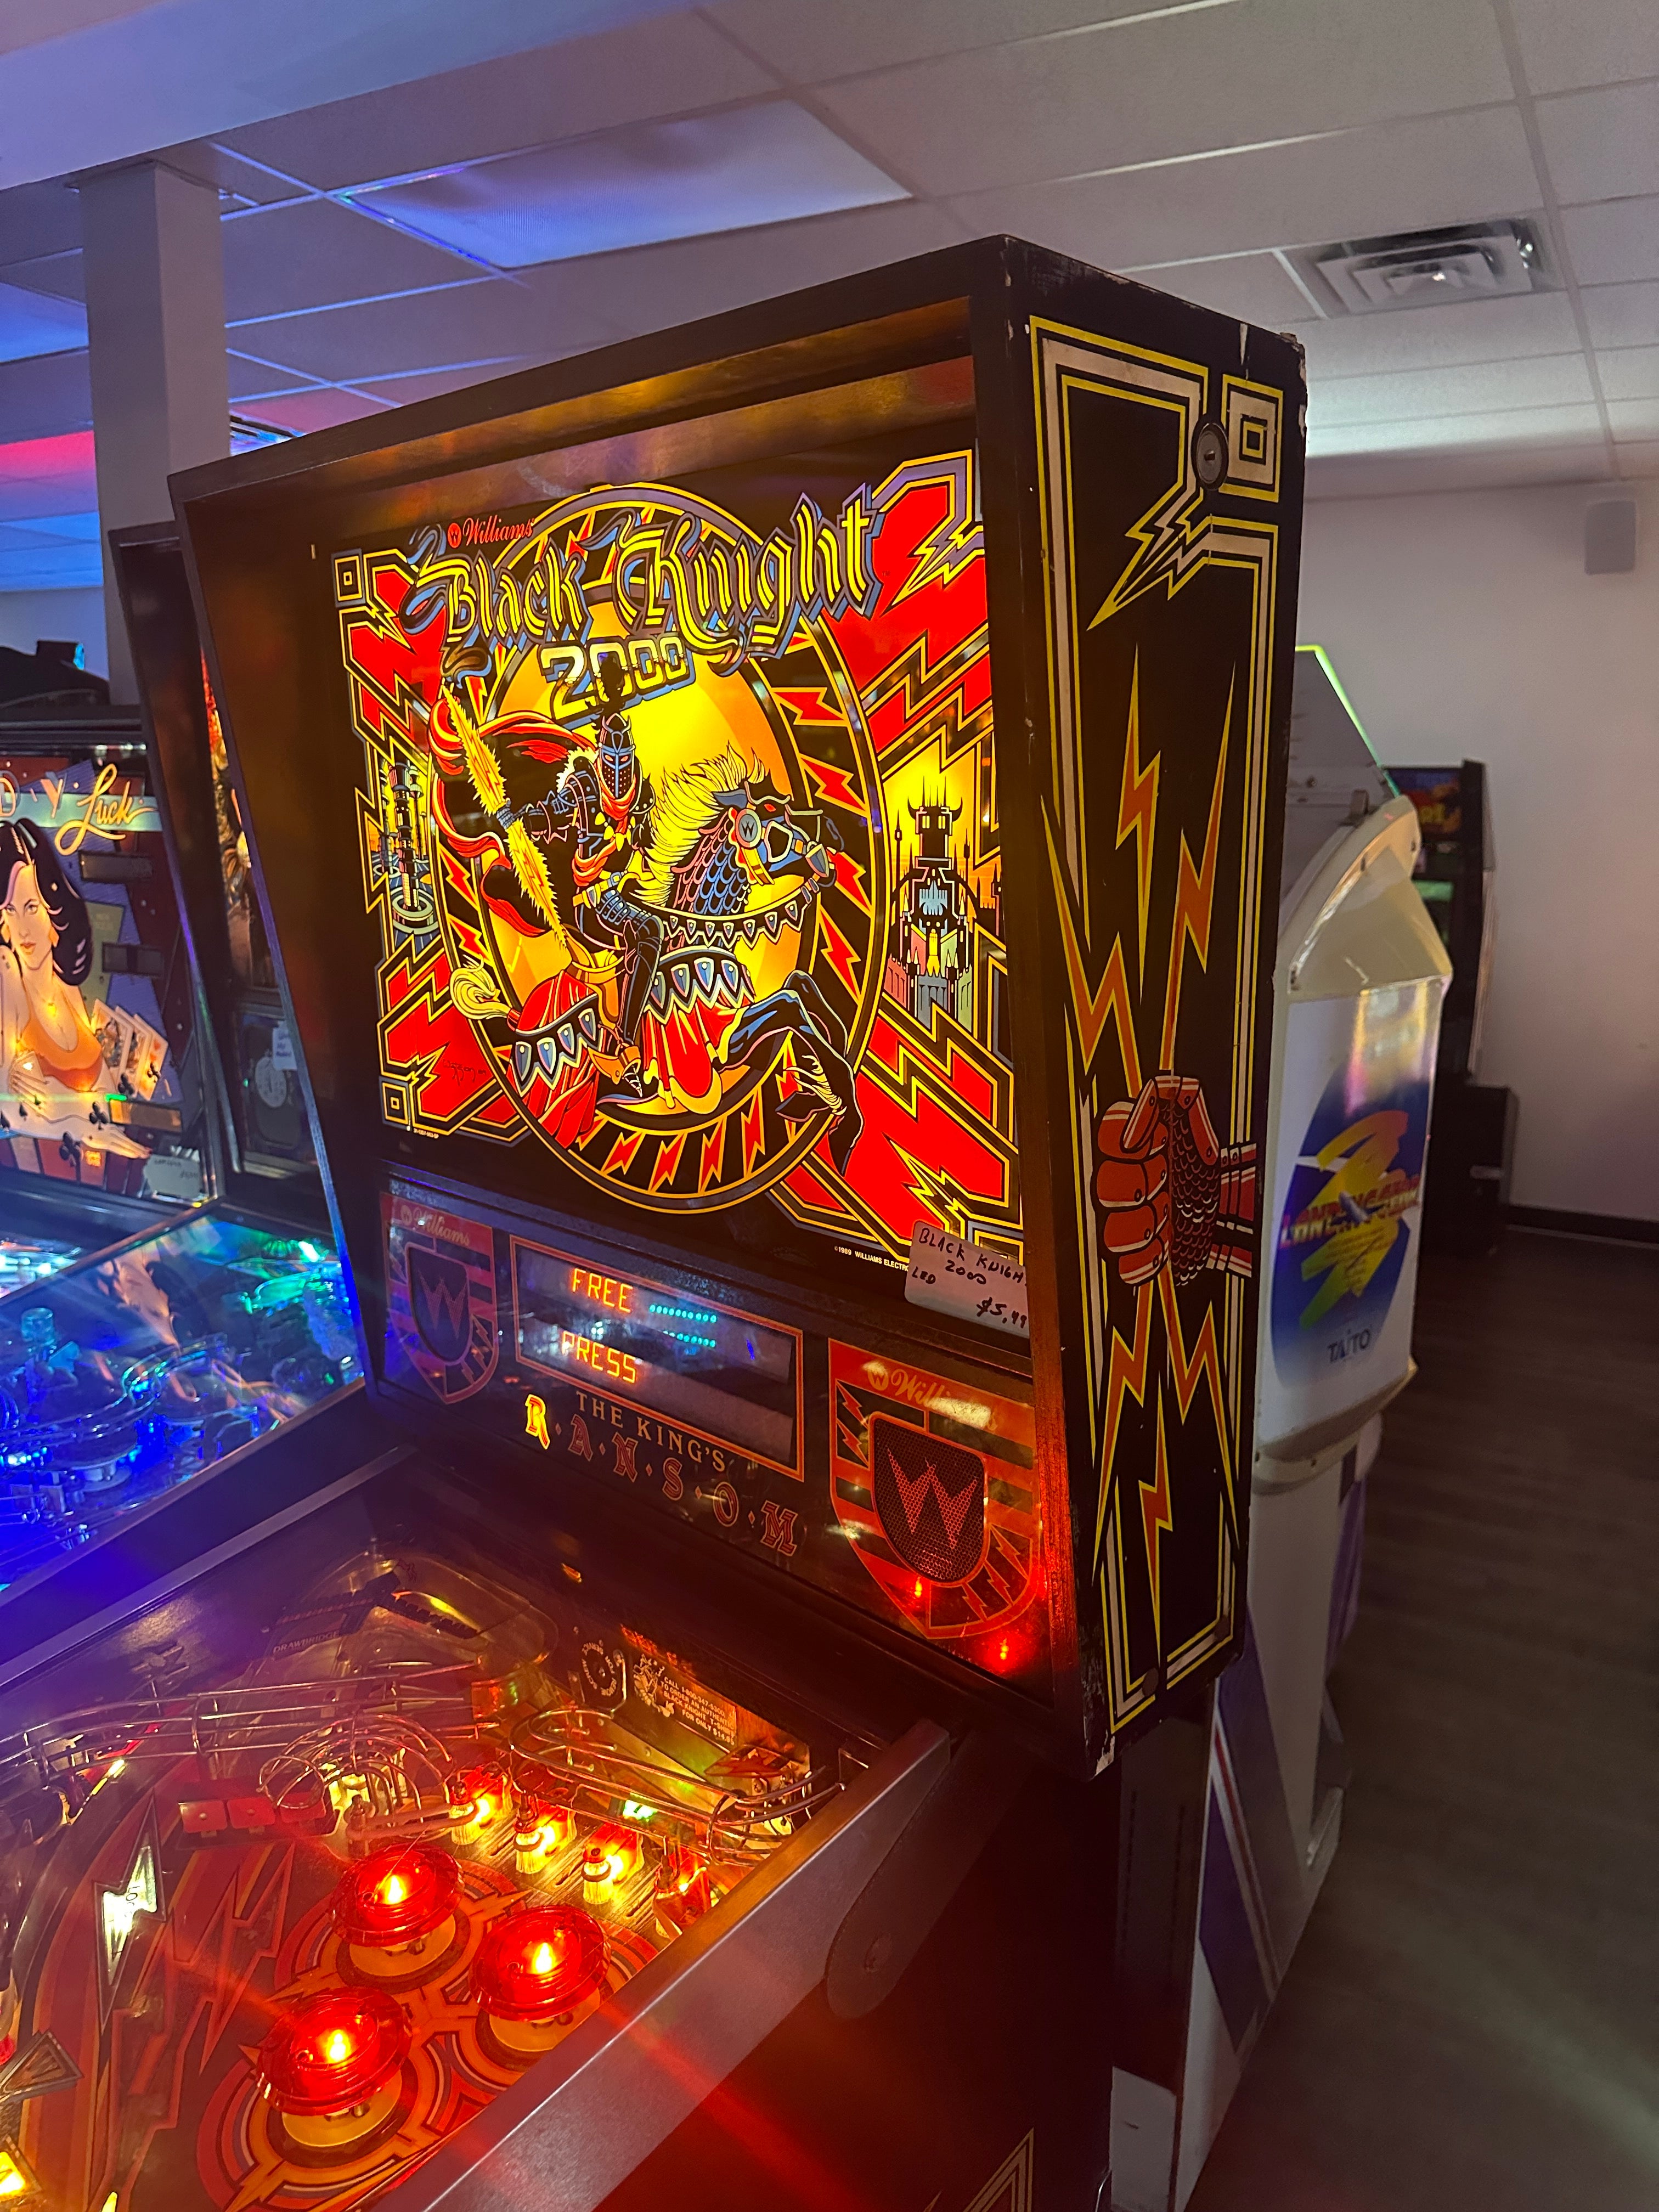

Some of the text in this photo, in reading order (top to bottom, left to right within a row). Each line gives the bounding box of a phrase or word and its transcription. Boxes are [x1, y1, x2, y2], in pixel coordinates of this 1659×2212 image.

[462, 514, 533, 546] Williams
[409, 486, 881, 662] Black Knight
[538, 635, 695, 730] 2000
[55, 763, 157, 856] Luck
[855, 1251, 883, 1264] WILLIAMS
[912, 1266, 936, 1285] LED
[919, 1227, 1028, 1287] BLACK KNIGH
[945, 1260, 987, 1285] 2000
[572, 1268, 634, 1313] FREE
[562, 1331, 636, 1384] PRESS
[891, 1369, 997, 1431] Wills
[576, 1390, 726, 1472] THE KING'S
[661, 1681, 669, 1690] TO
[670, 1688, 689, 1703] ORDER
[691, 1700, 699, 1709] AN
[664, 1677, 679, 1690] CALL
[664, 1691, 684, 1707] BLACK
[685, 1703, 706, 1720] KNIGHT
[682, 1709, 695, 1721] FOR
[696, 1718, 712, 1731] ONLY
